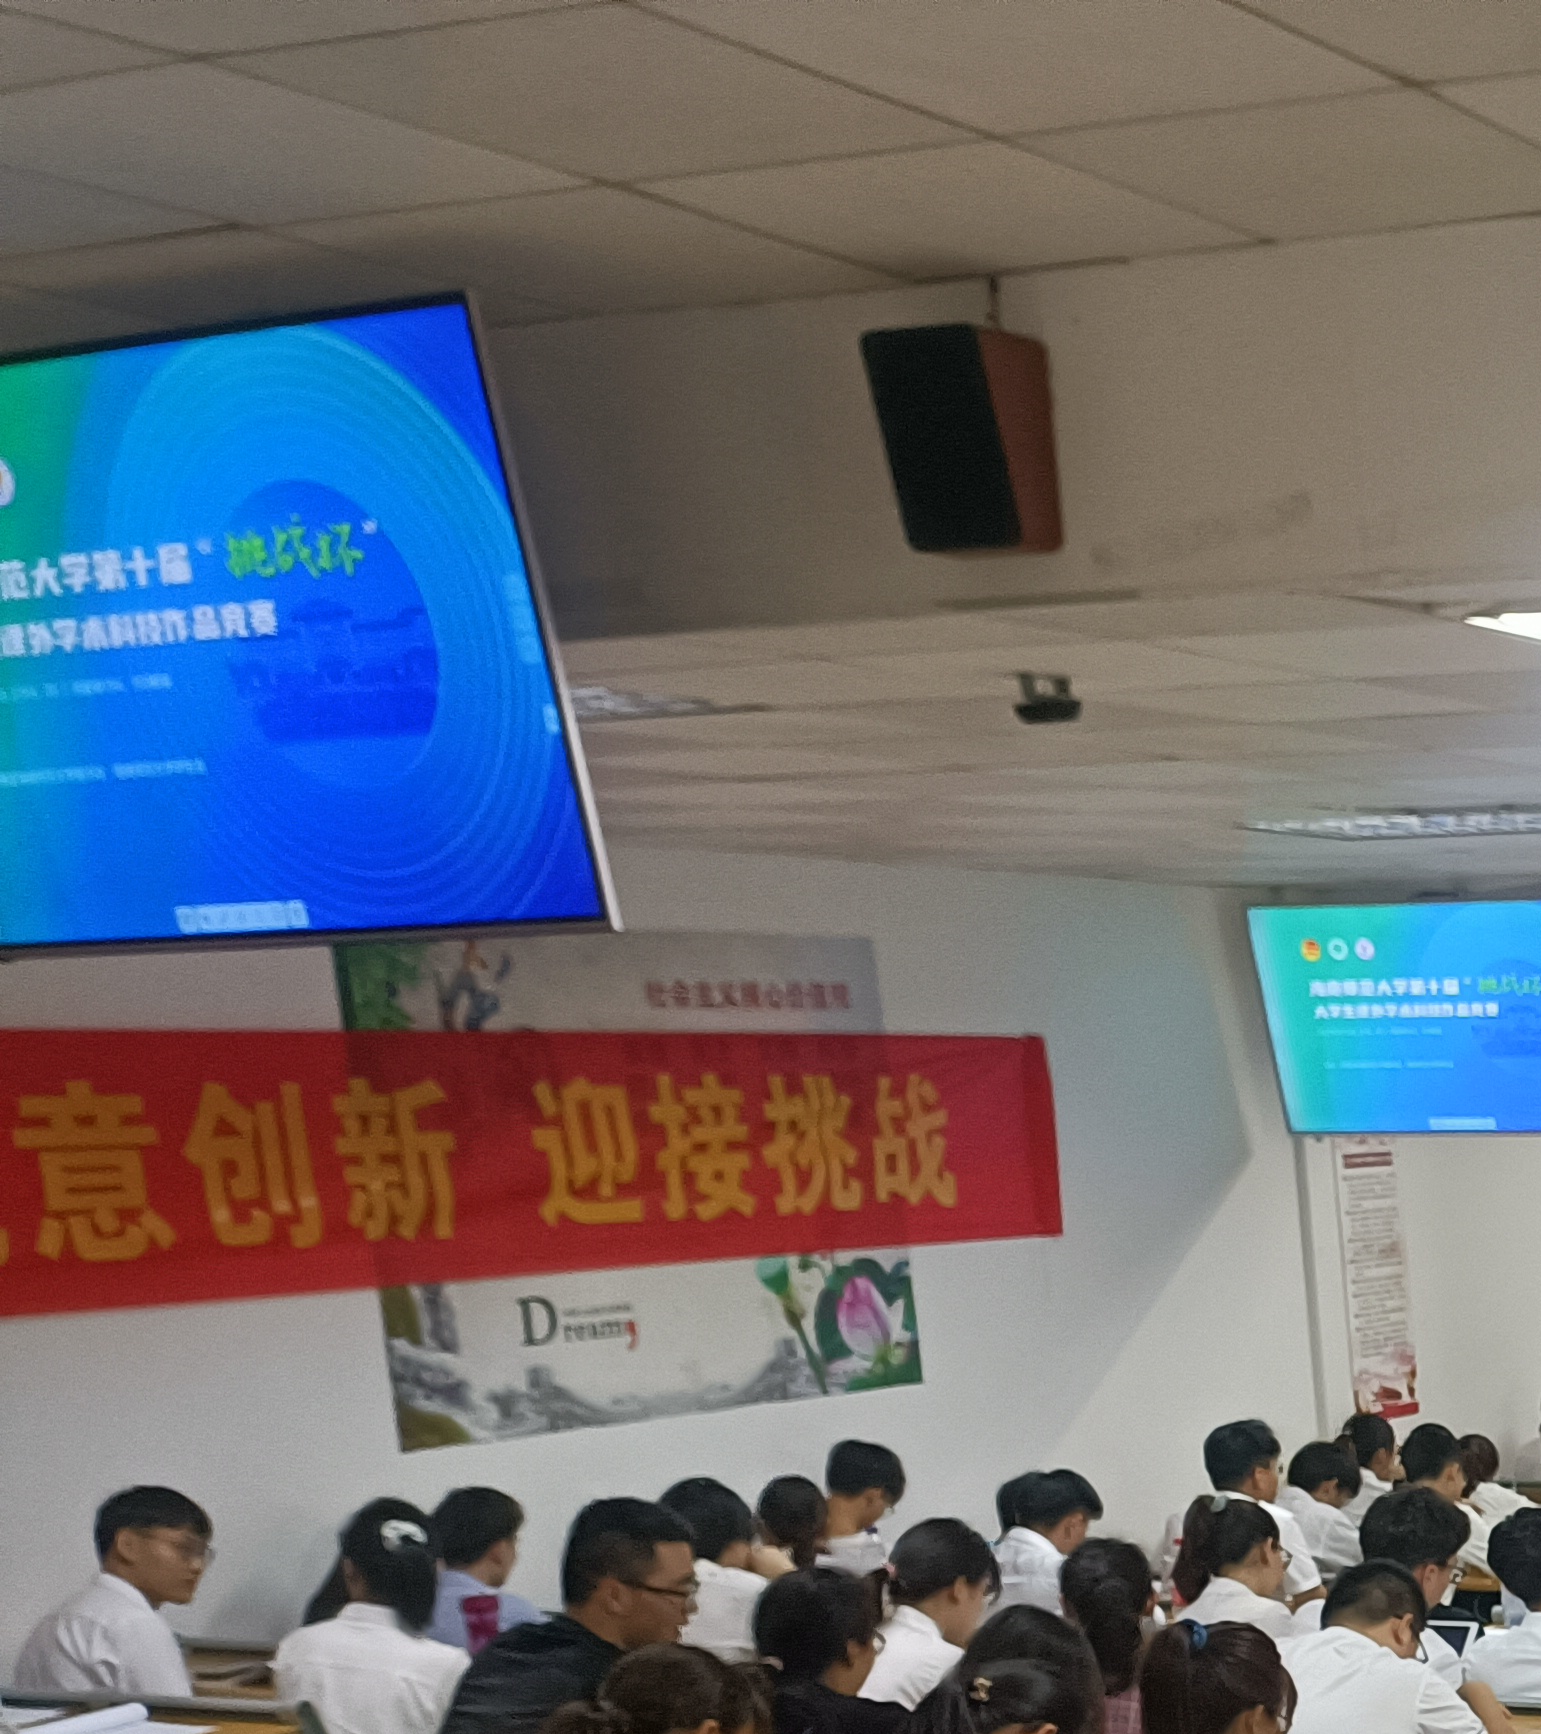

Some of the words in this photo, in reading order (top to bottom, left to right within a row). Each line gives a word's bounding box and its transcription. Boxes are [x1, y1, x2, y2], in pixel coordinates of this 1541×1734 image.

[0, 1078, 458, 1263] 意创新
[530, 1072, 957, 1228] 迎接挑战
